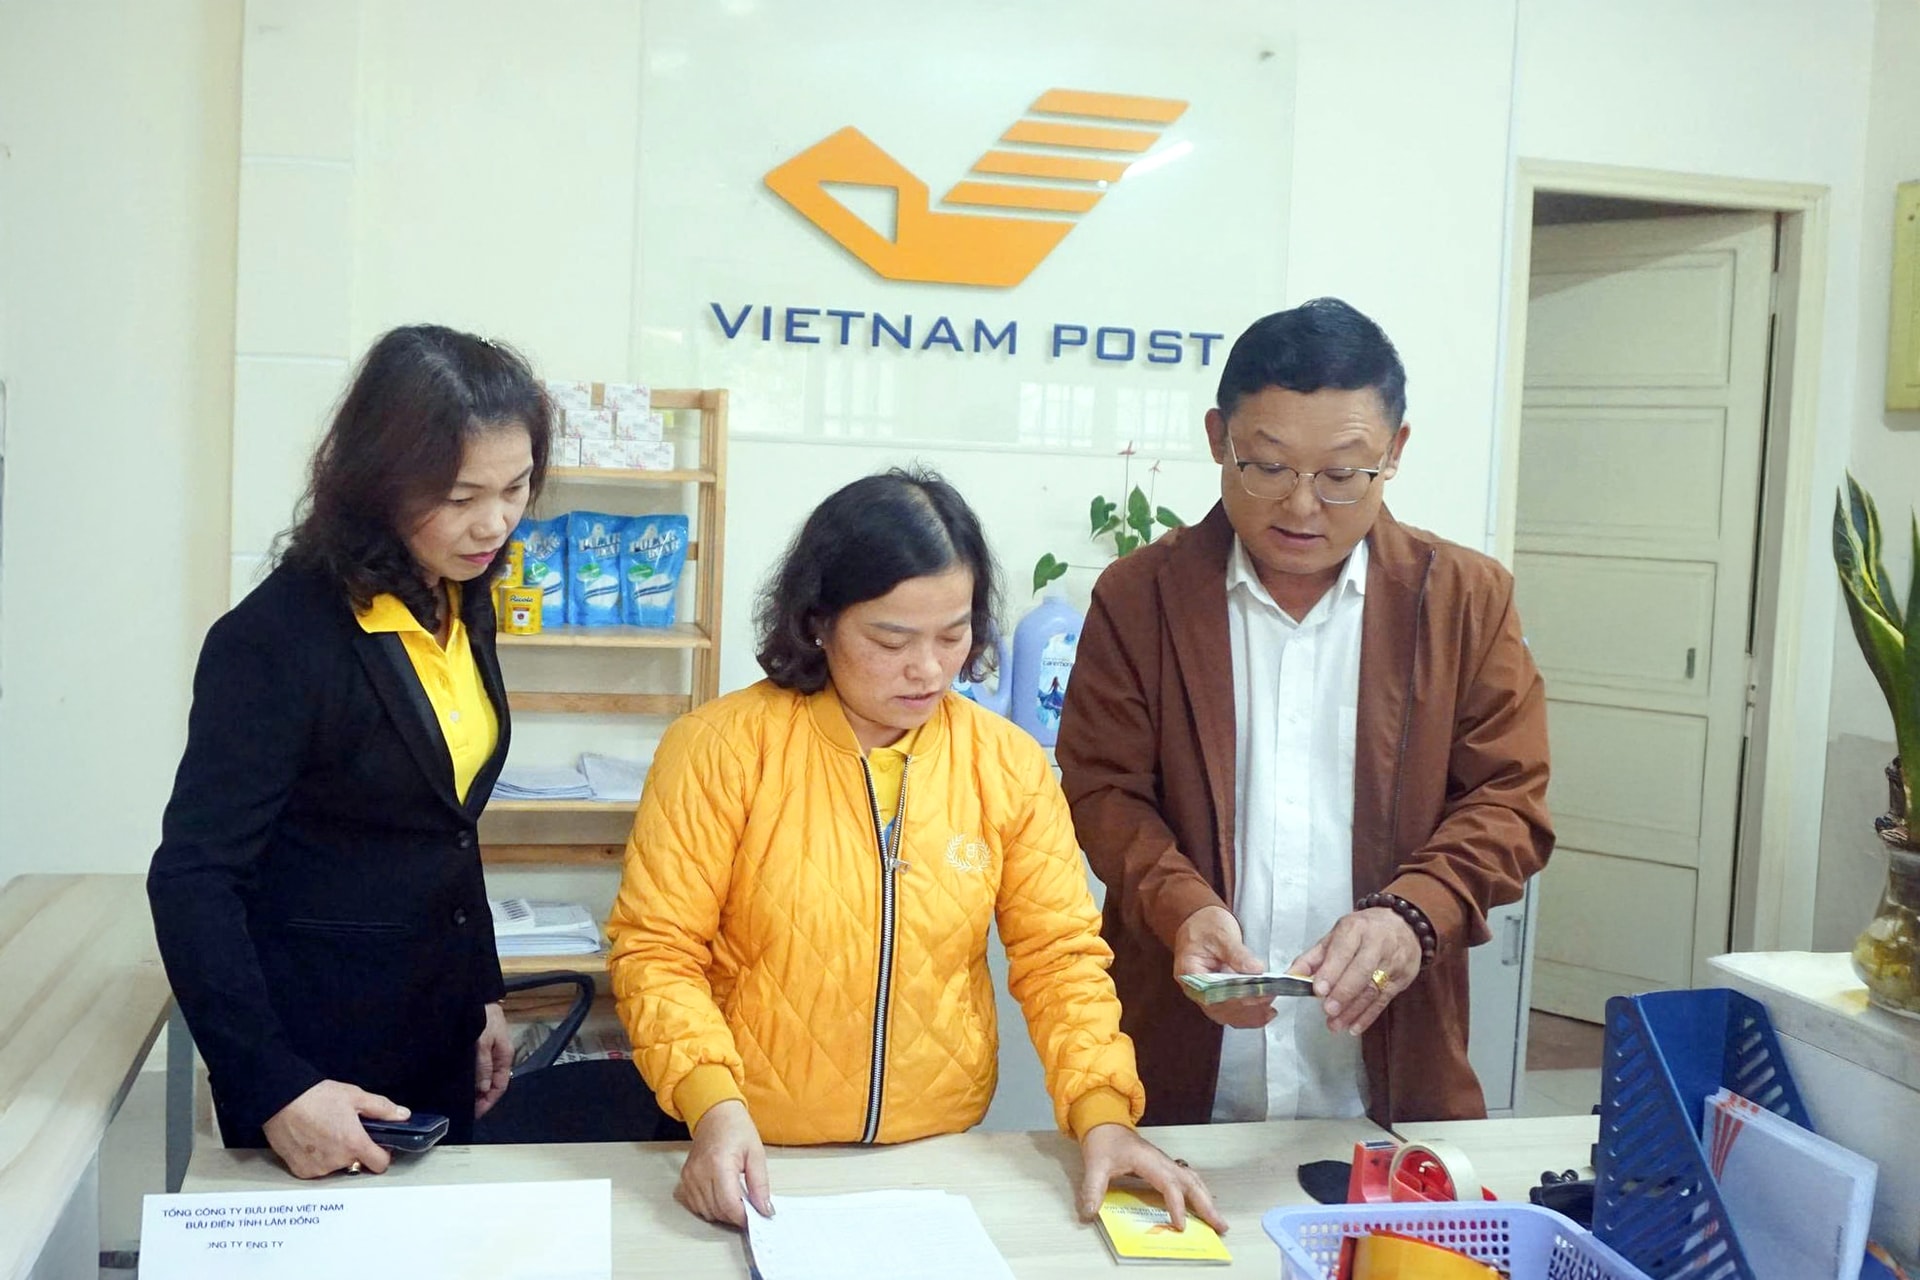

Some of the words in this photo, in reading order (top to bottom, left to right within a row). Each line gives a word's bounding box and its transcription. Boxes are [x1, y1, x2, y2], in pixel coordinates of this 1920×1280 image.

[709, 302, 1018, 355] VIETNAM
[1052, 323, 1225, 367] POST
[229, 1206, 242, 1215] TY
[320, 1203, 344, 1212] NAM
[230, 1240, 243, 1248] TY
[271, 1240, 284, 1248] TY
